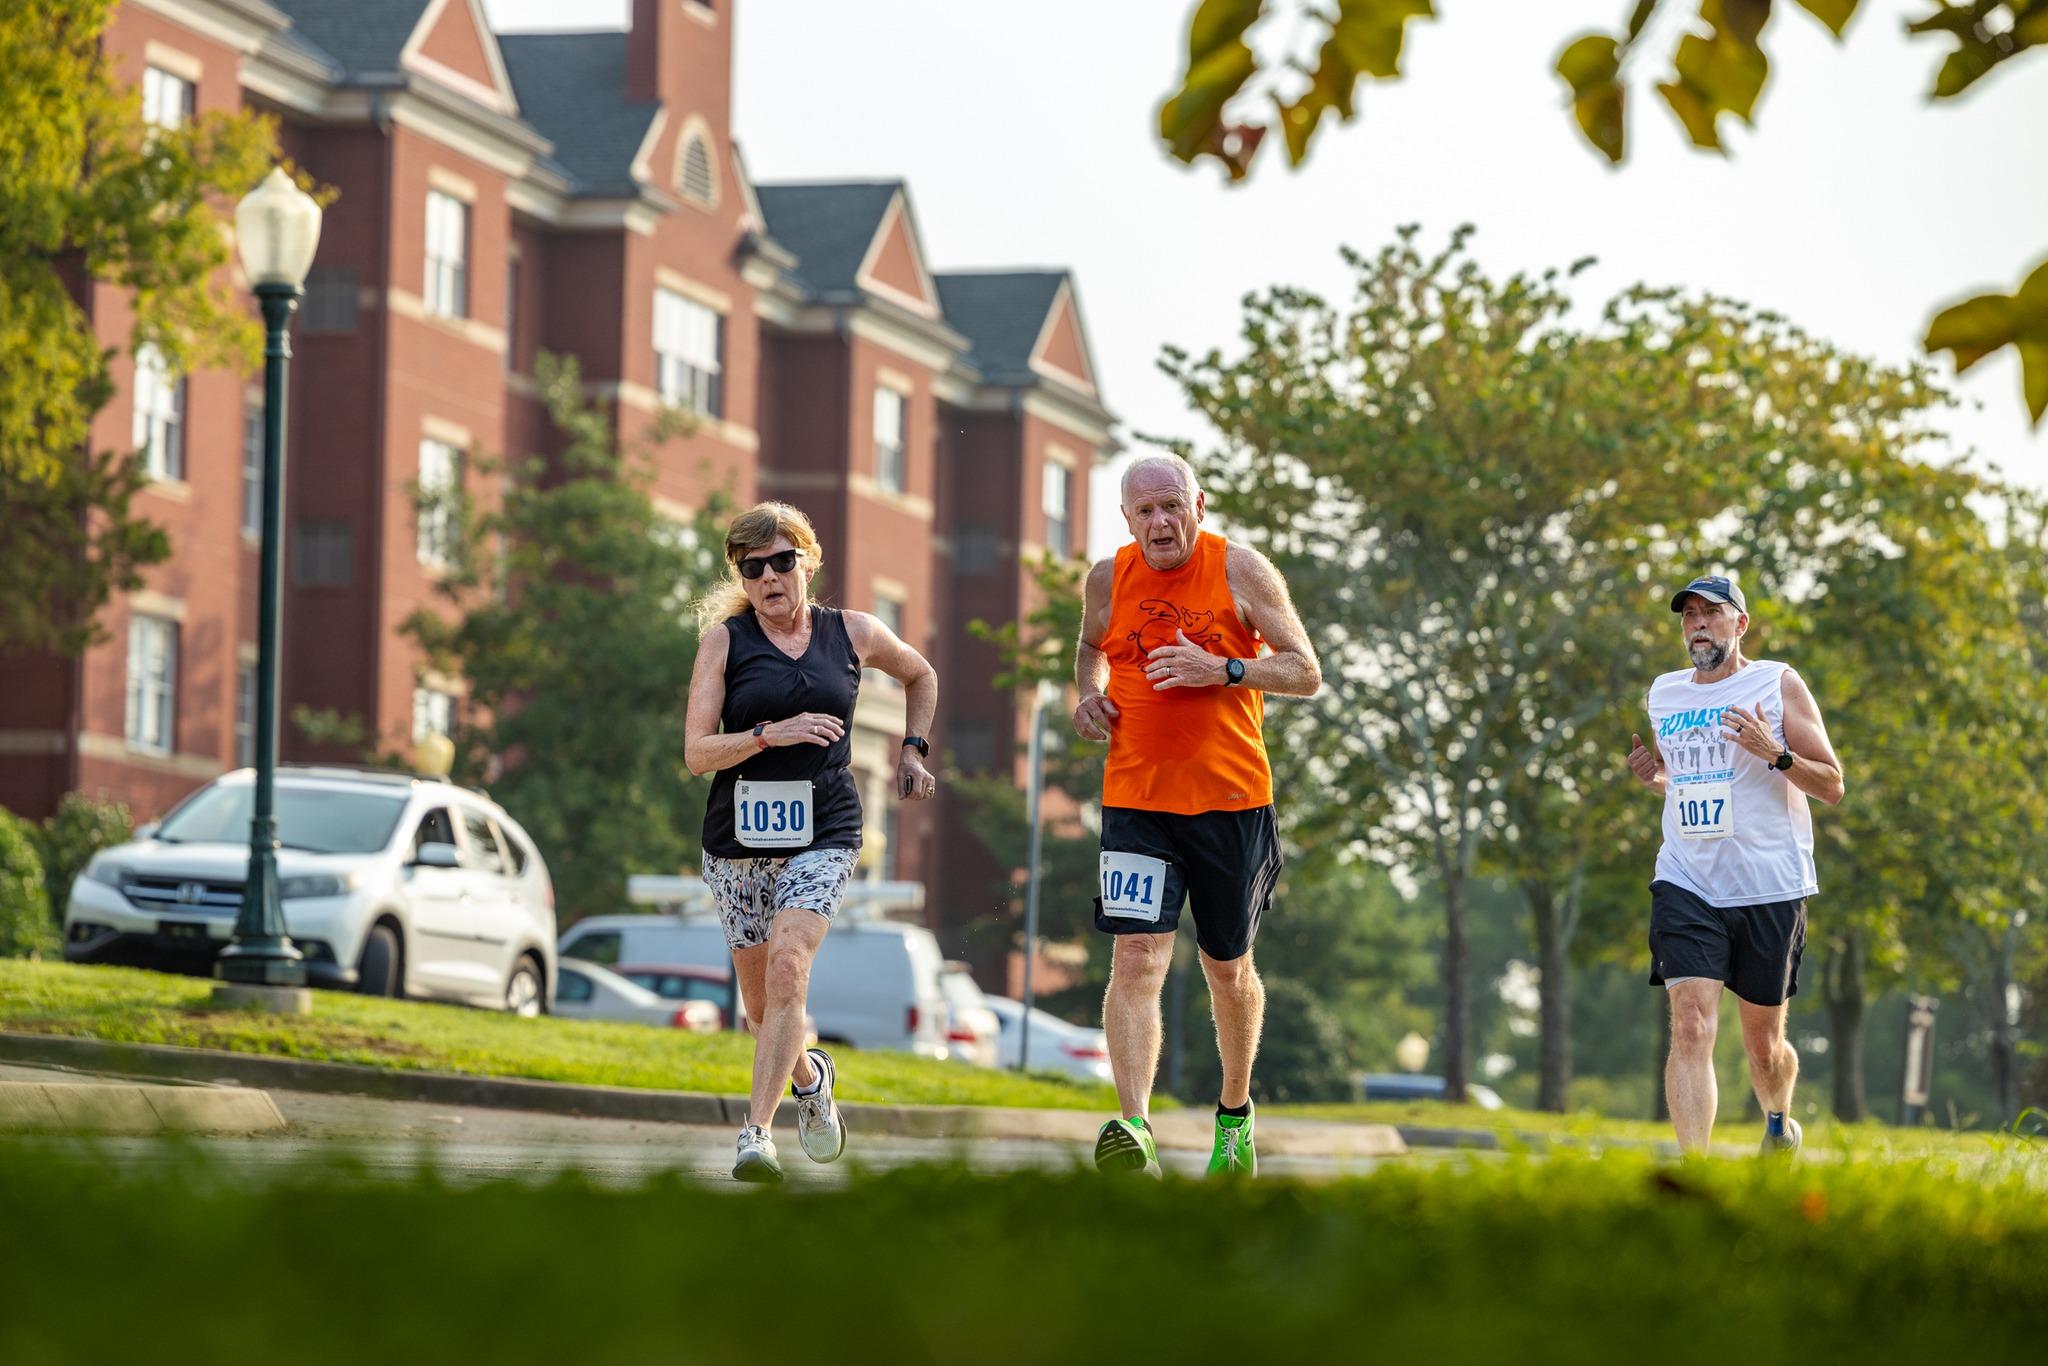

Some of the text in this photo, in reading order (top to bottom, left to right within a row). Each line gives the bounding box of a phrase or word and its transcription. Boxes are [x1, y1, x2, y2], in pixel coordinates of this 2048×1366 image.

[740, 800, 805, 831] 1030
[1679, 799, 1725, 827] 1017
[1103, 870, 1153, 905] 1041
